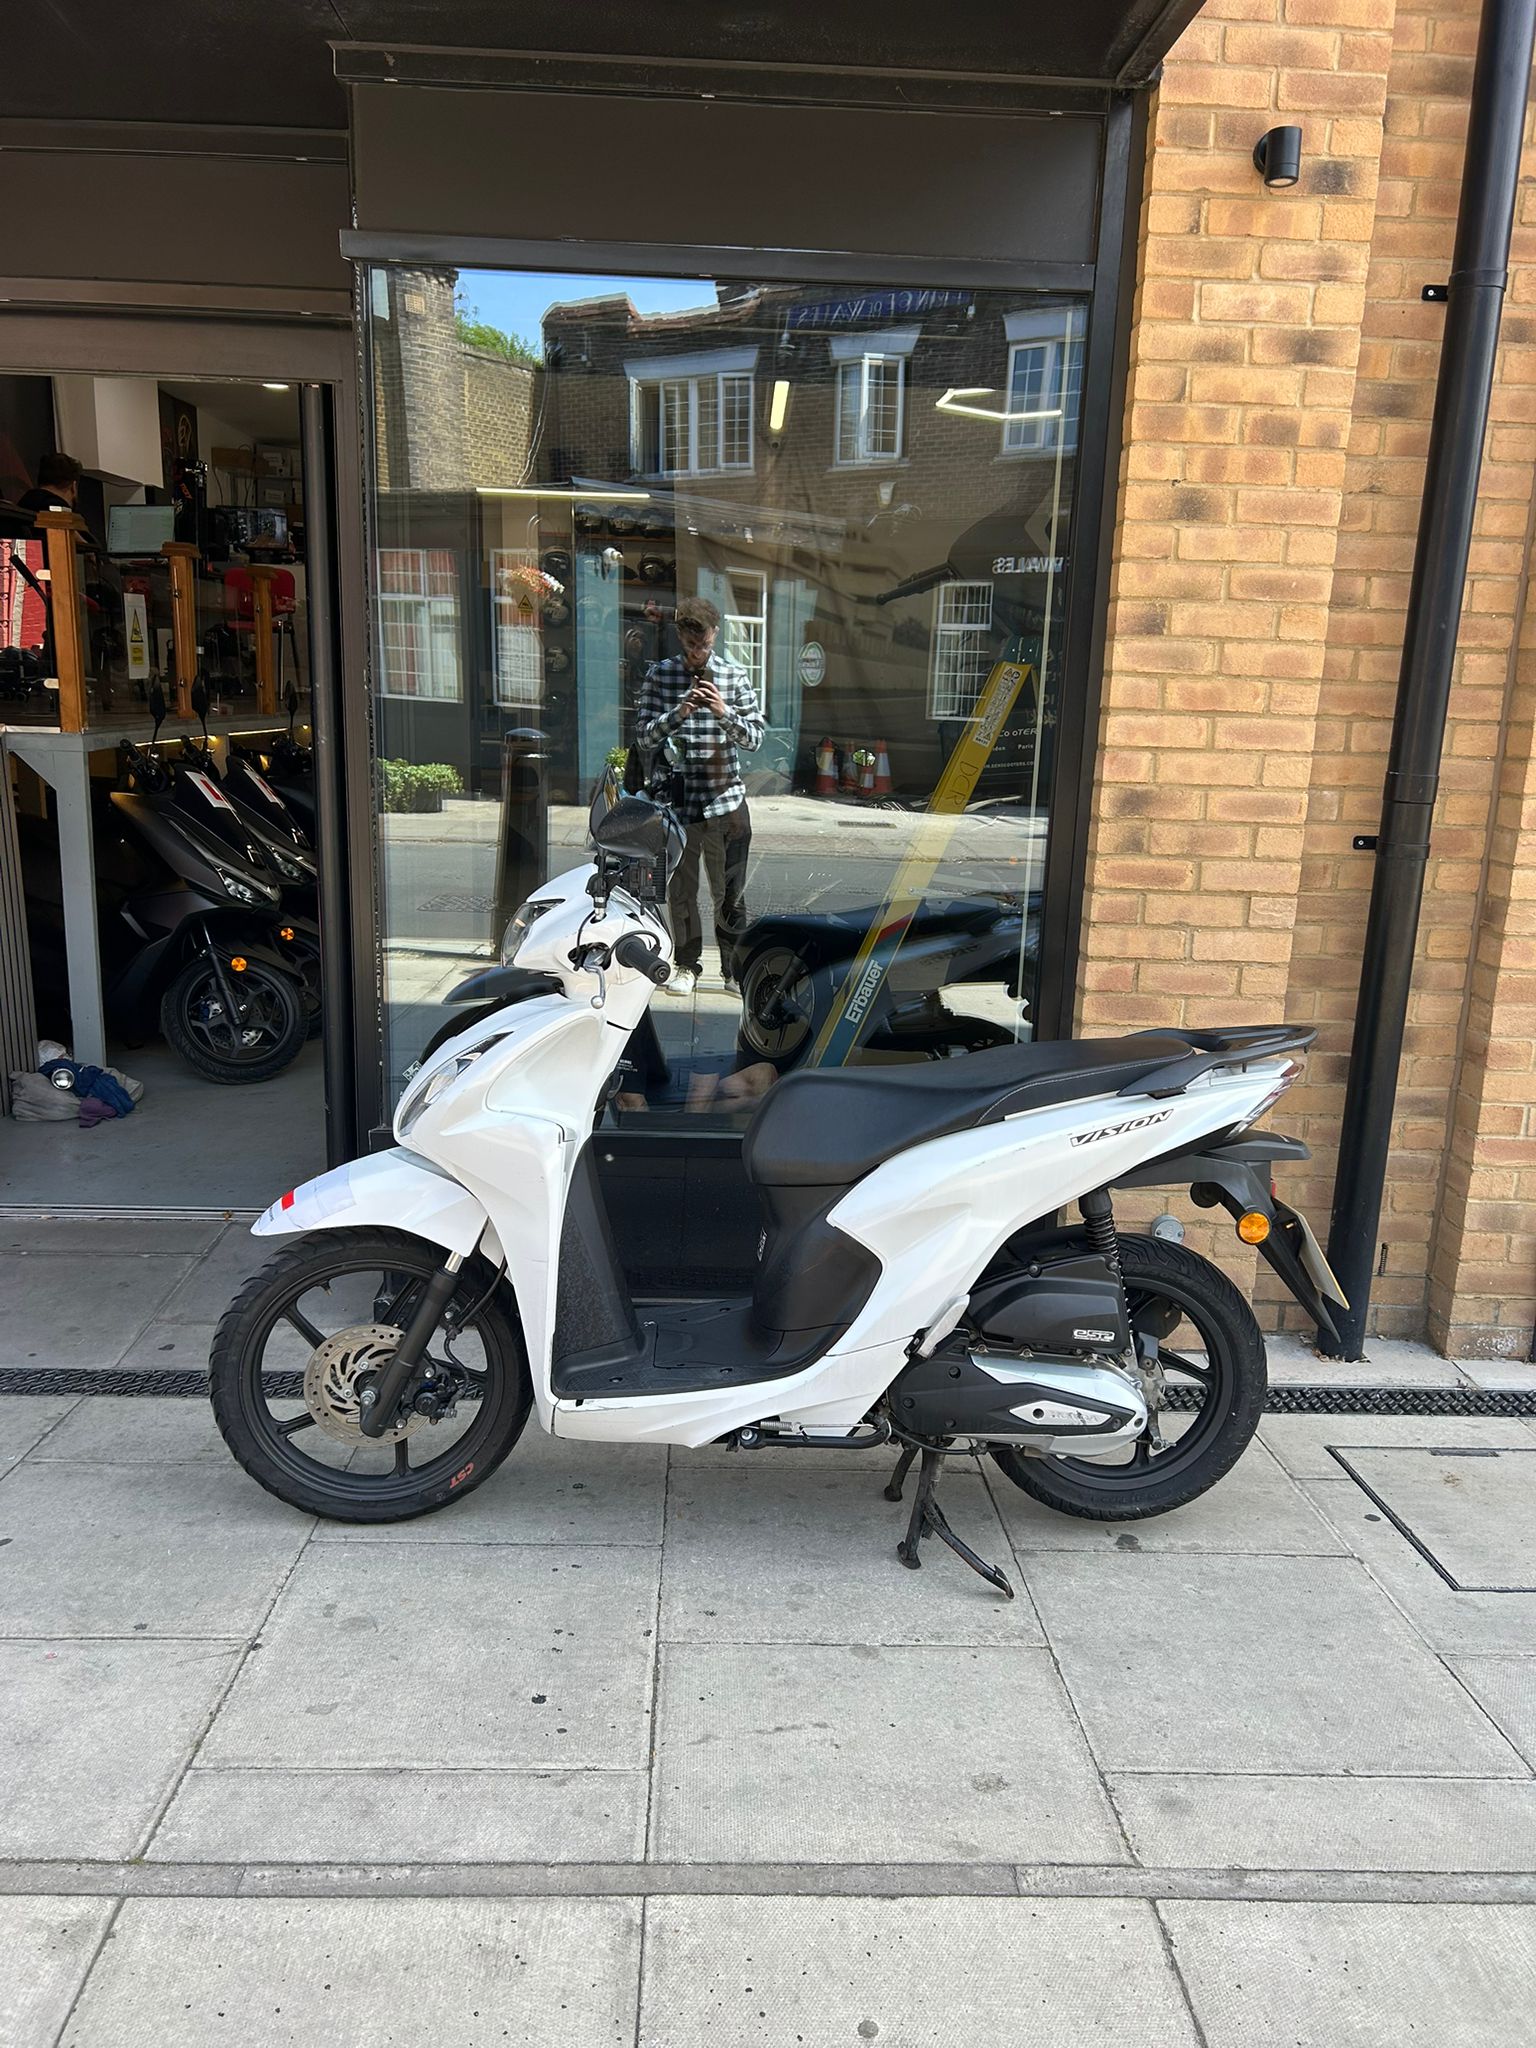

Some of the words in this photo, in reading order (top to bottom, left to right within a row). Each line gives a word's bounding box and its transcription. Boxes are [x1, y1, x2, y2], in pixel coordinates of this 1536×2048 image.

[844, 959, 884, 1023] Erbauer
[1070, 1108, 1175, 1148] VISION
[449, 1461, 475, 1489] CST
